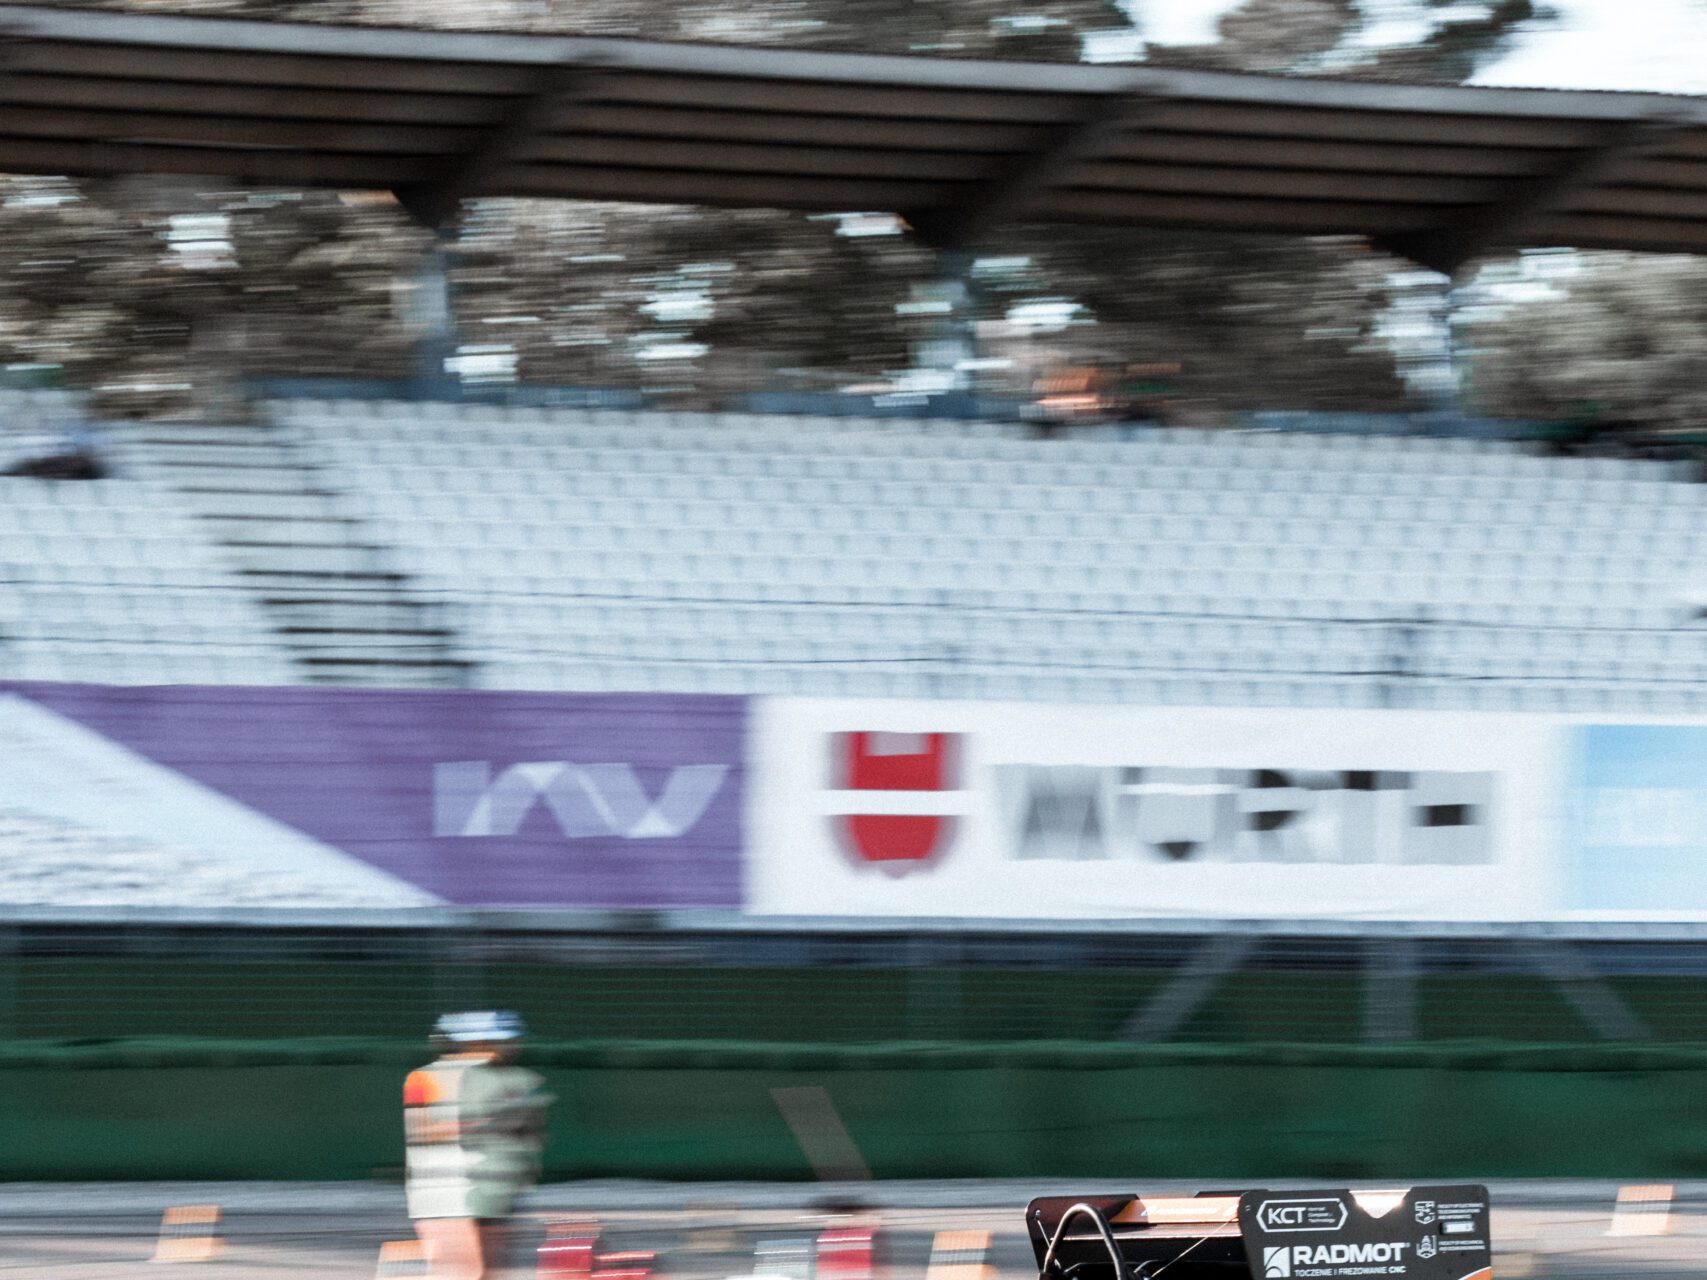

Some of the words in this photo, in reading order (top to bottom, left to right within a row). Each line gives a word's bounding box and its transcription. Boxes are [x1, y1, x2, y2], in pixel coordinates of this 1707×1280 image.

[1267, 1206, 1306, 1224] KCT
[1293, 1242, 1406, 1265] RADMOT
[1388, 1265, 1407, 1274] CNC
